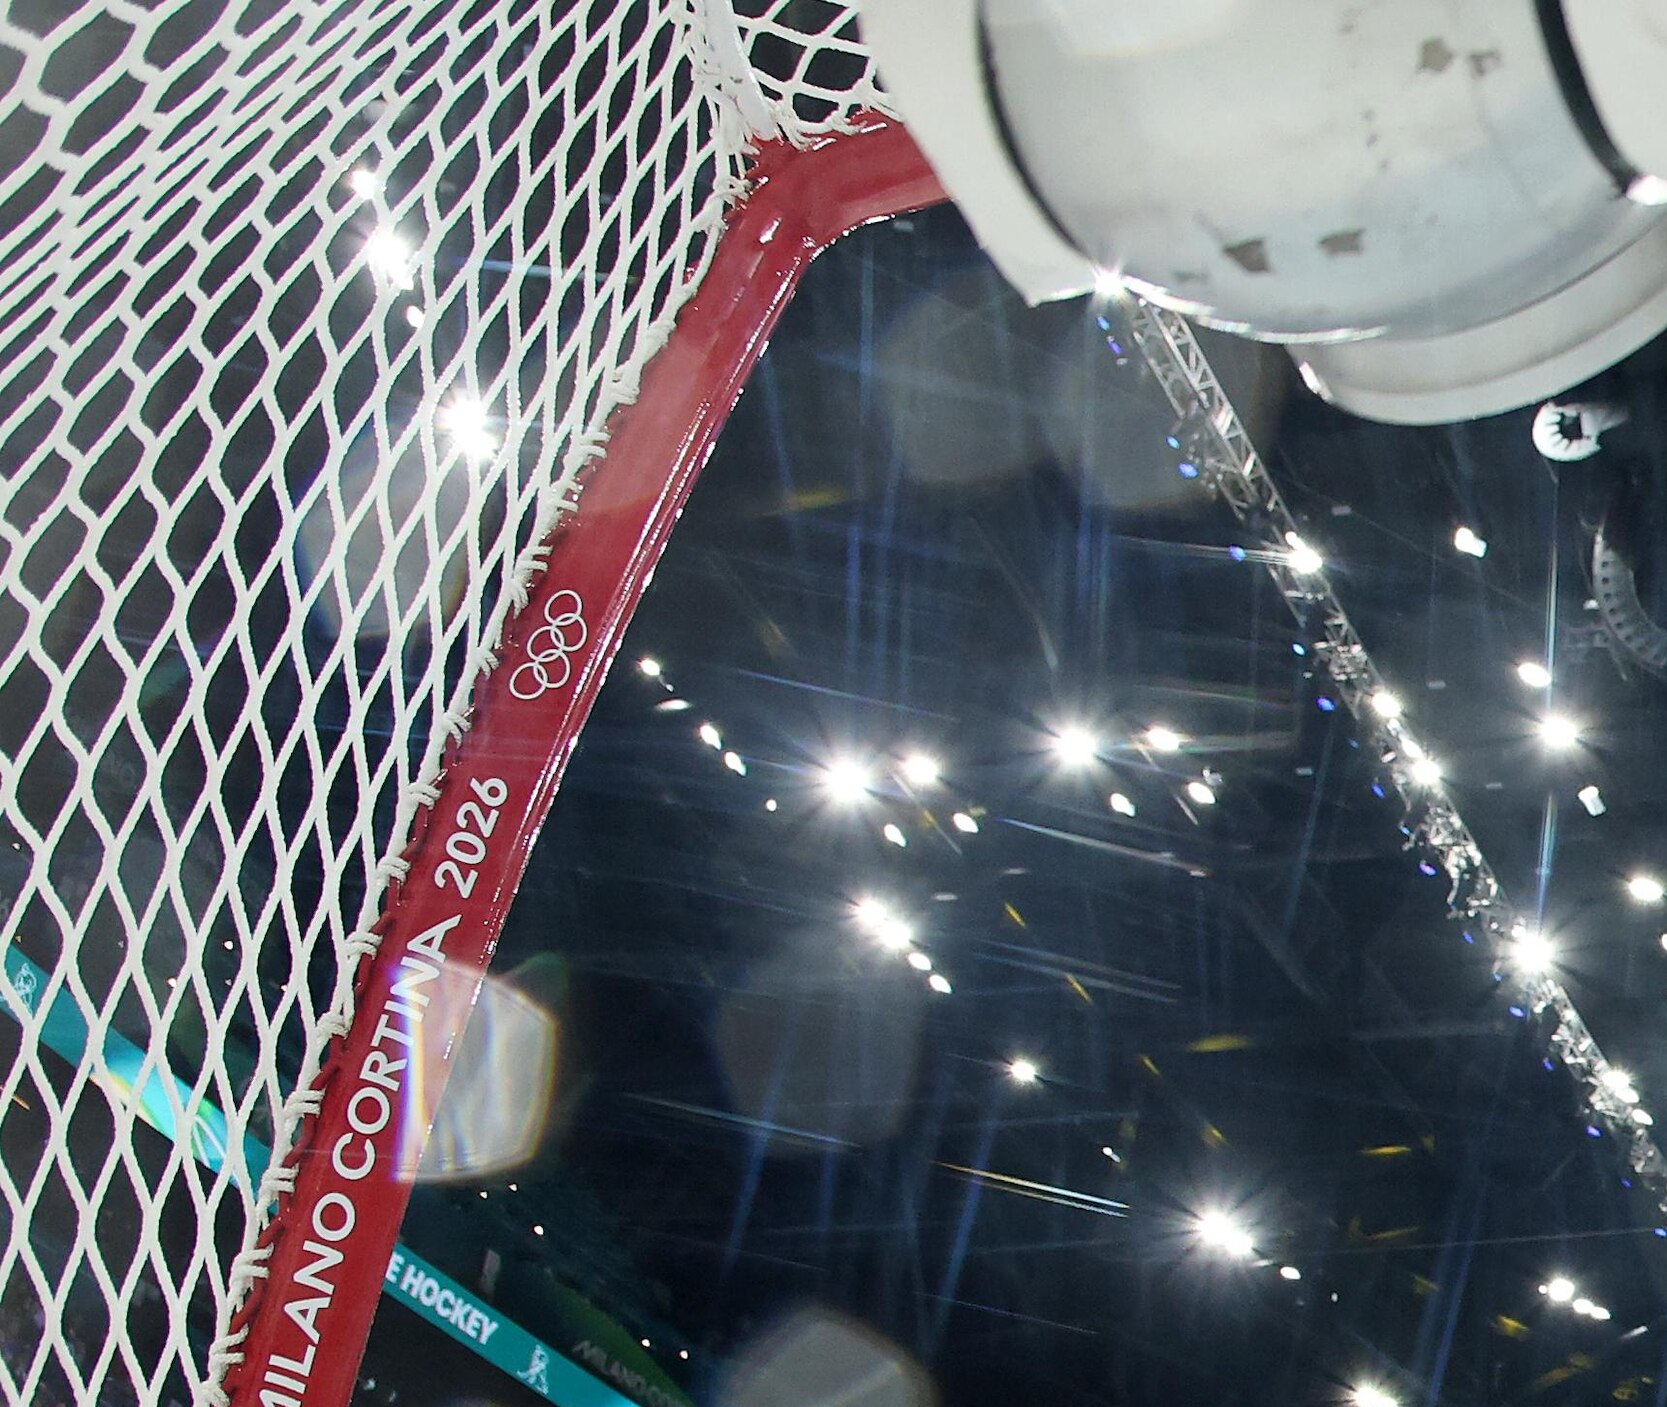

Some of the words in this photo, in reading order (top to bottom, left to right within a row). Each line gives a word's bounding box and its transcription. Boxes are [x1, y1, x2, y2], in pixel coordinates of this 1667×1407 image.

[332, 914, 462, 1180] CORTINA
[434, 777, 508, 898] 2026
[400, 1264, 499, 1345] HOCKEY
